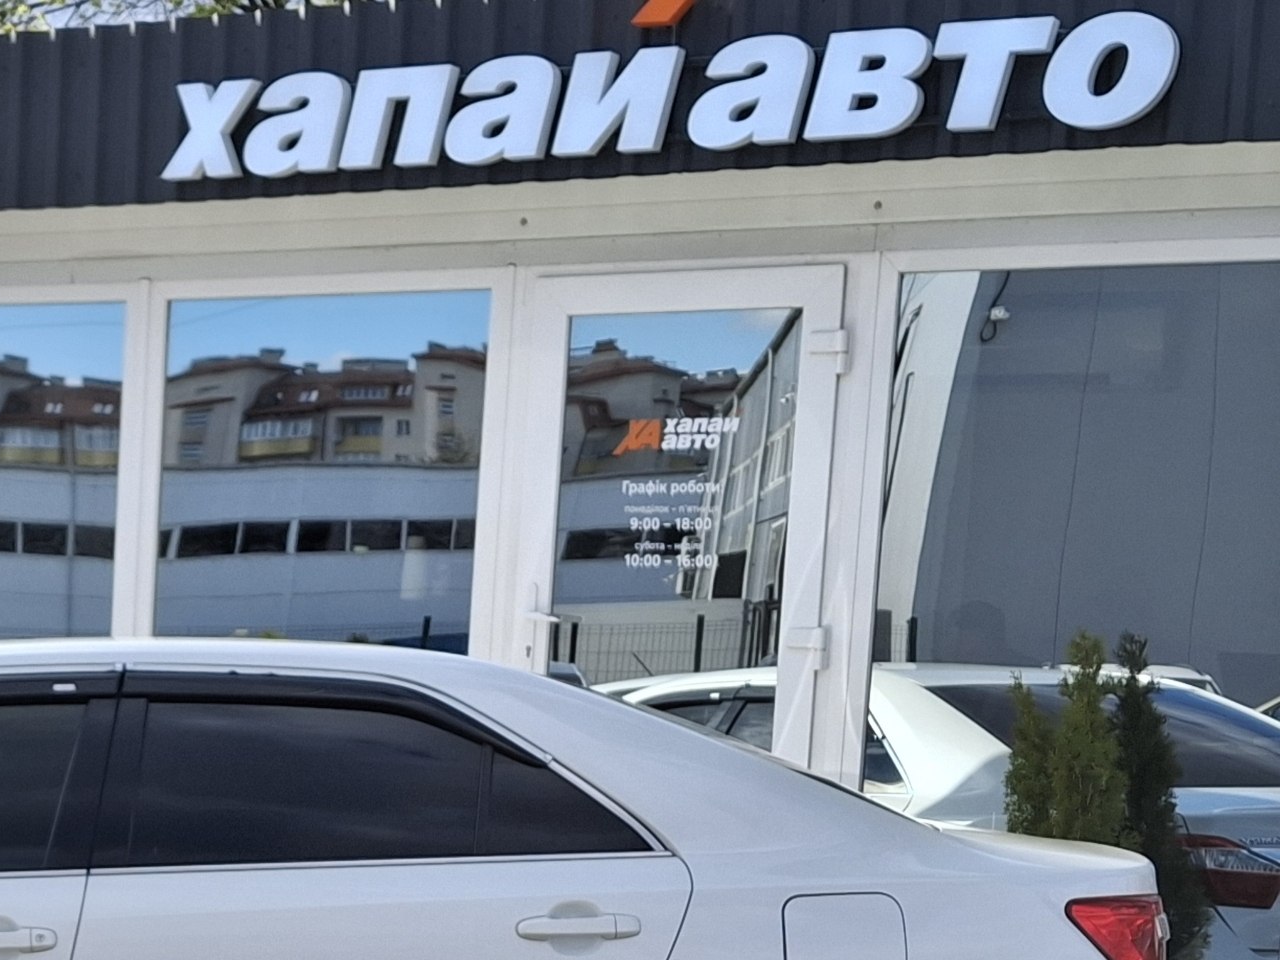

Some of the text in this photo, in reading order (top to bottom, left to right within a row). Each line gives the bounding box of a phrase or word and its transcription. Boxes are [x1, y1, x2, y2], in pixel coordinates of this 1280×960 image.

[687, 10, 1182, 153] авто
[661, 433, 721, 451] авто
[622, 480, 668, 497] Графік
[630, 517, 660, 532] 9:00
[675, 517, 712, 532] 18:00
[634, 541, 666, 552] субота
[624, 553, 661, 568] 10:00
[676, 553, 713, 568] 16:00
